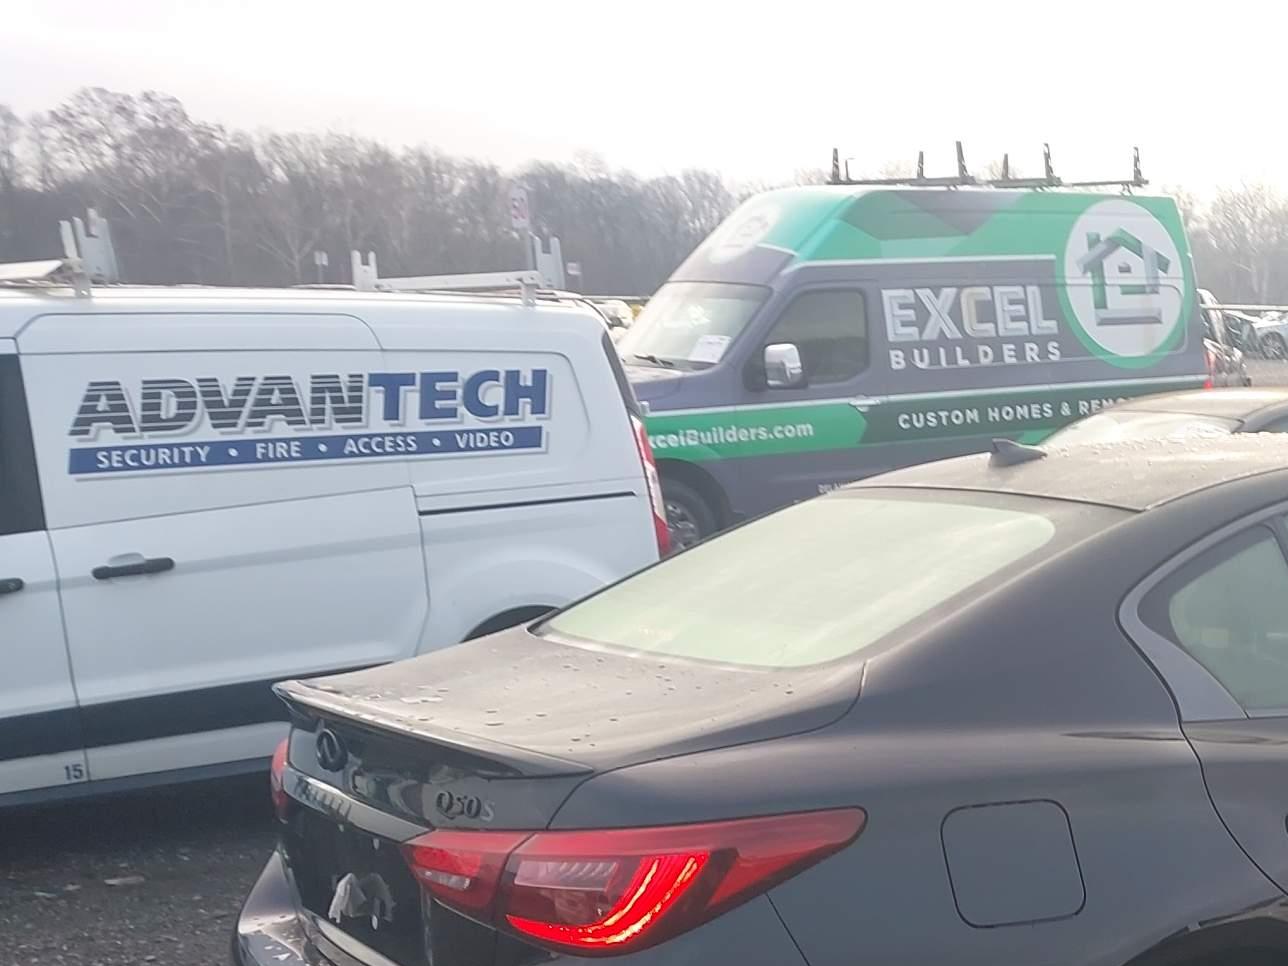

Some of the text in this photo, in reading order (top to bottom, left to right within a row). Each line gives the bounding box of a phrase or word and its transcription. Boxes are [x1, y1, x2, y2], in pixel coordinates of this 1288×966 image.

[880, 285, 1059, 343] EXCEL
[889, 341, 1062, 370] BUILDERS
[68, 368, 548, 437] ADVANTECH
[898, 397, 1135, 430] CUSTOM HOMES & REM
[96, 430, 515, 469] SECURITY FIRE ACCESS VIDEO
[64, 763, 85, 781] 15
